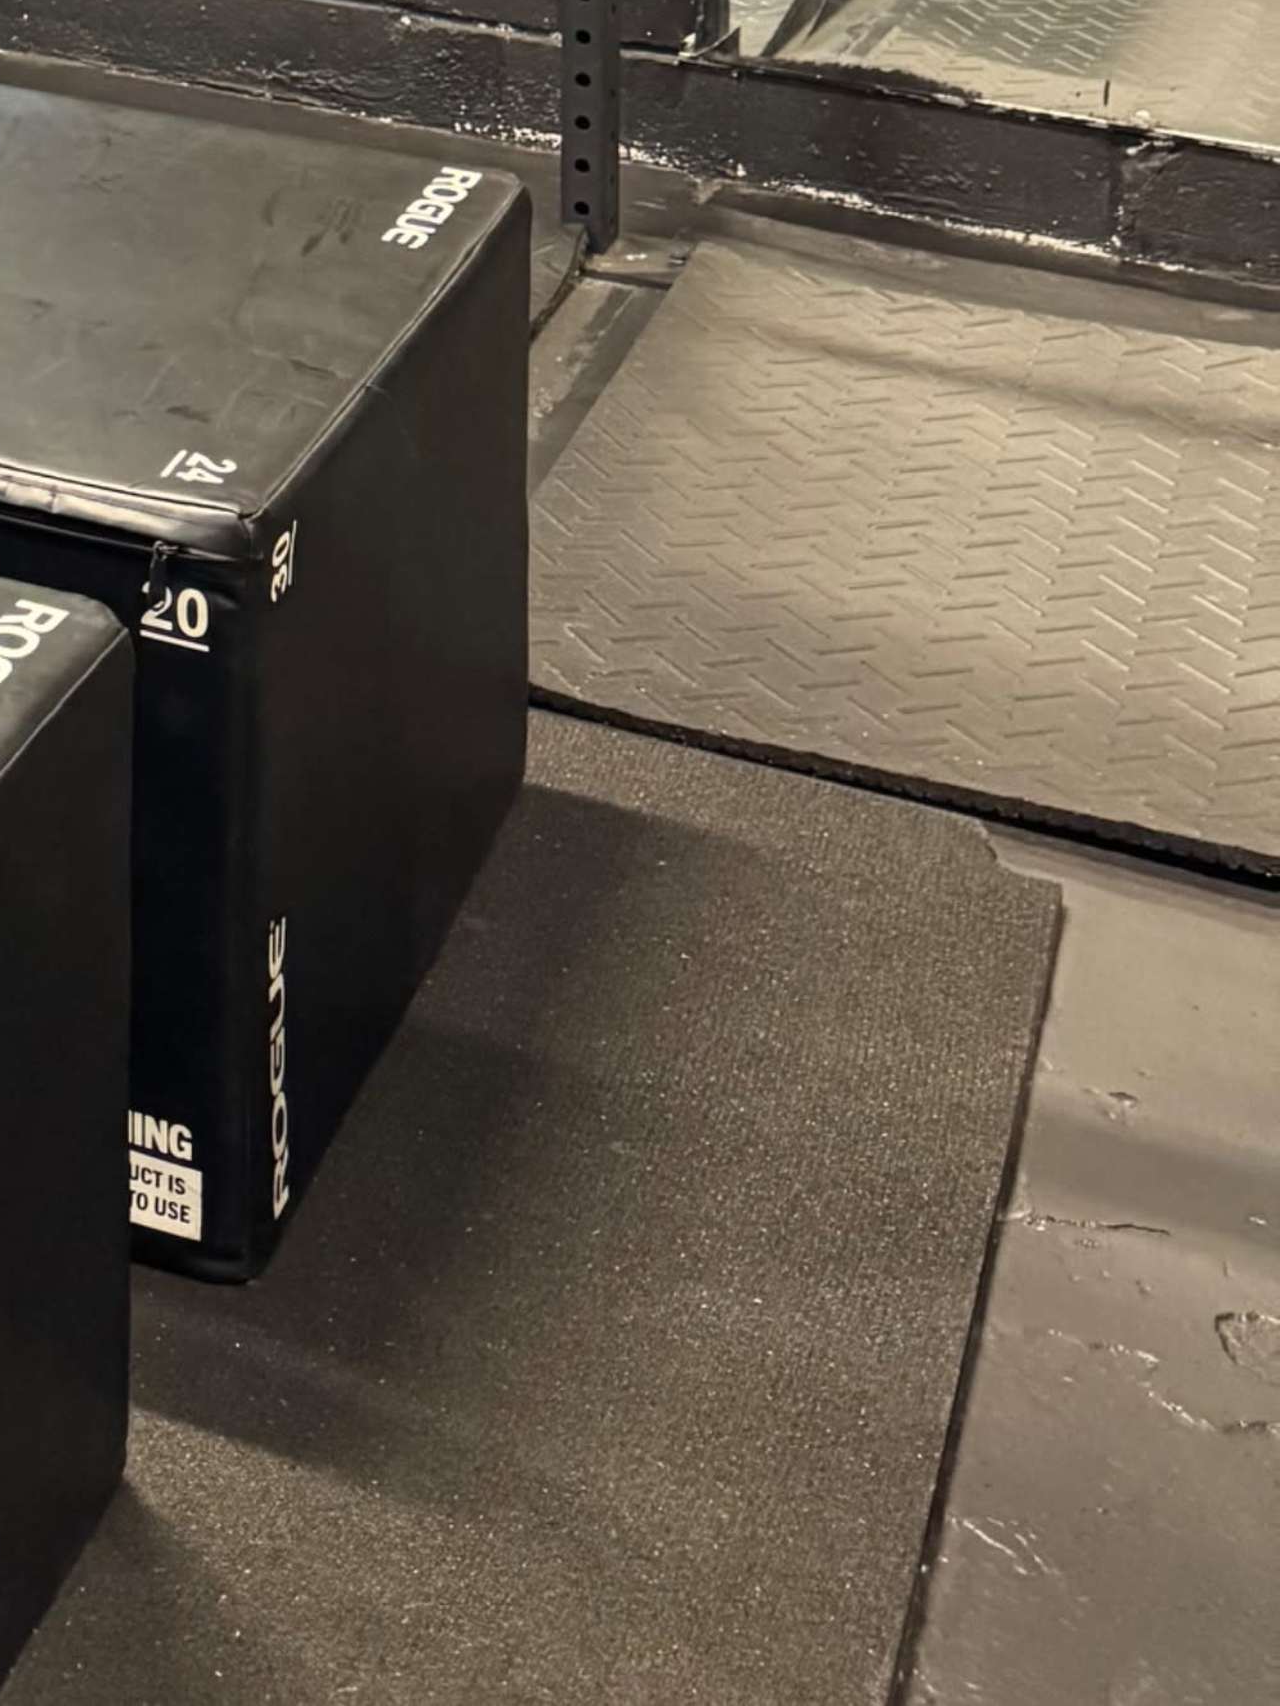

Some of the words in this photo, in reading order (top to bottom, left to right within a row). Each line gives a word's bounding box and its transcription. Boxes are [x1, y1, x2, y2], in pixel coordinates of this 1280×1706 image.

[381, 166, 483, 249] ROGUE
[176, 451, 238, 484] 24
[270, 531, 291, 603] 30
[141, 581, 209, 638] 20
[268, 917, 290, 1219] ROGUE
[130, 1109, 193, 1161] ING
[154, 1195, 192, 1225] USE
[168, 1173, 186, 1196] IS
